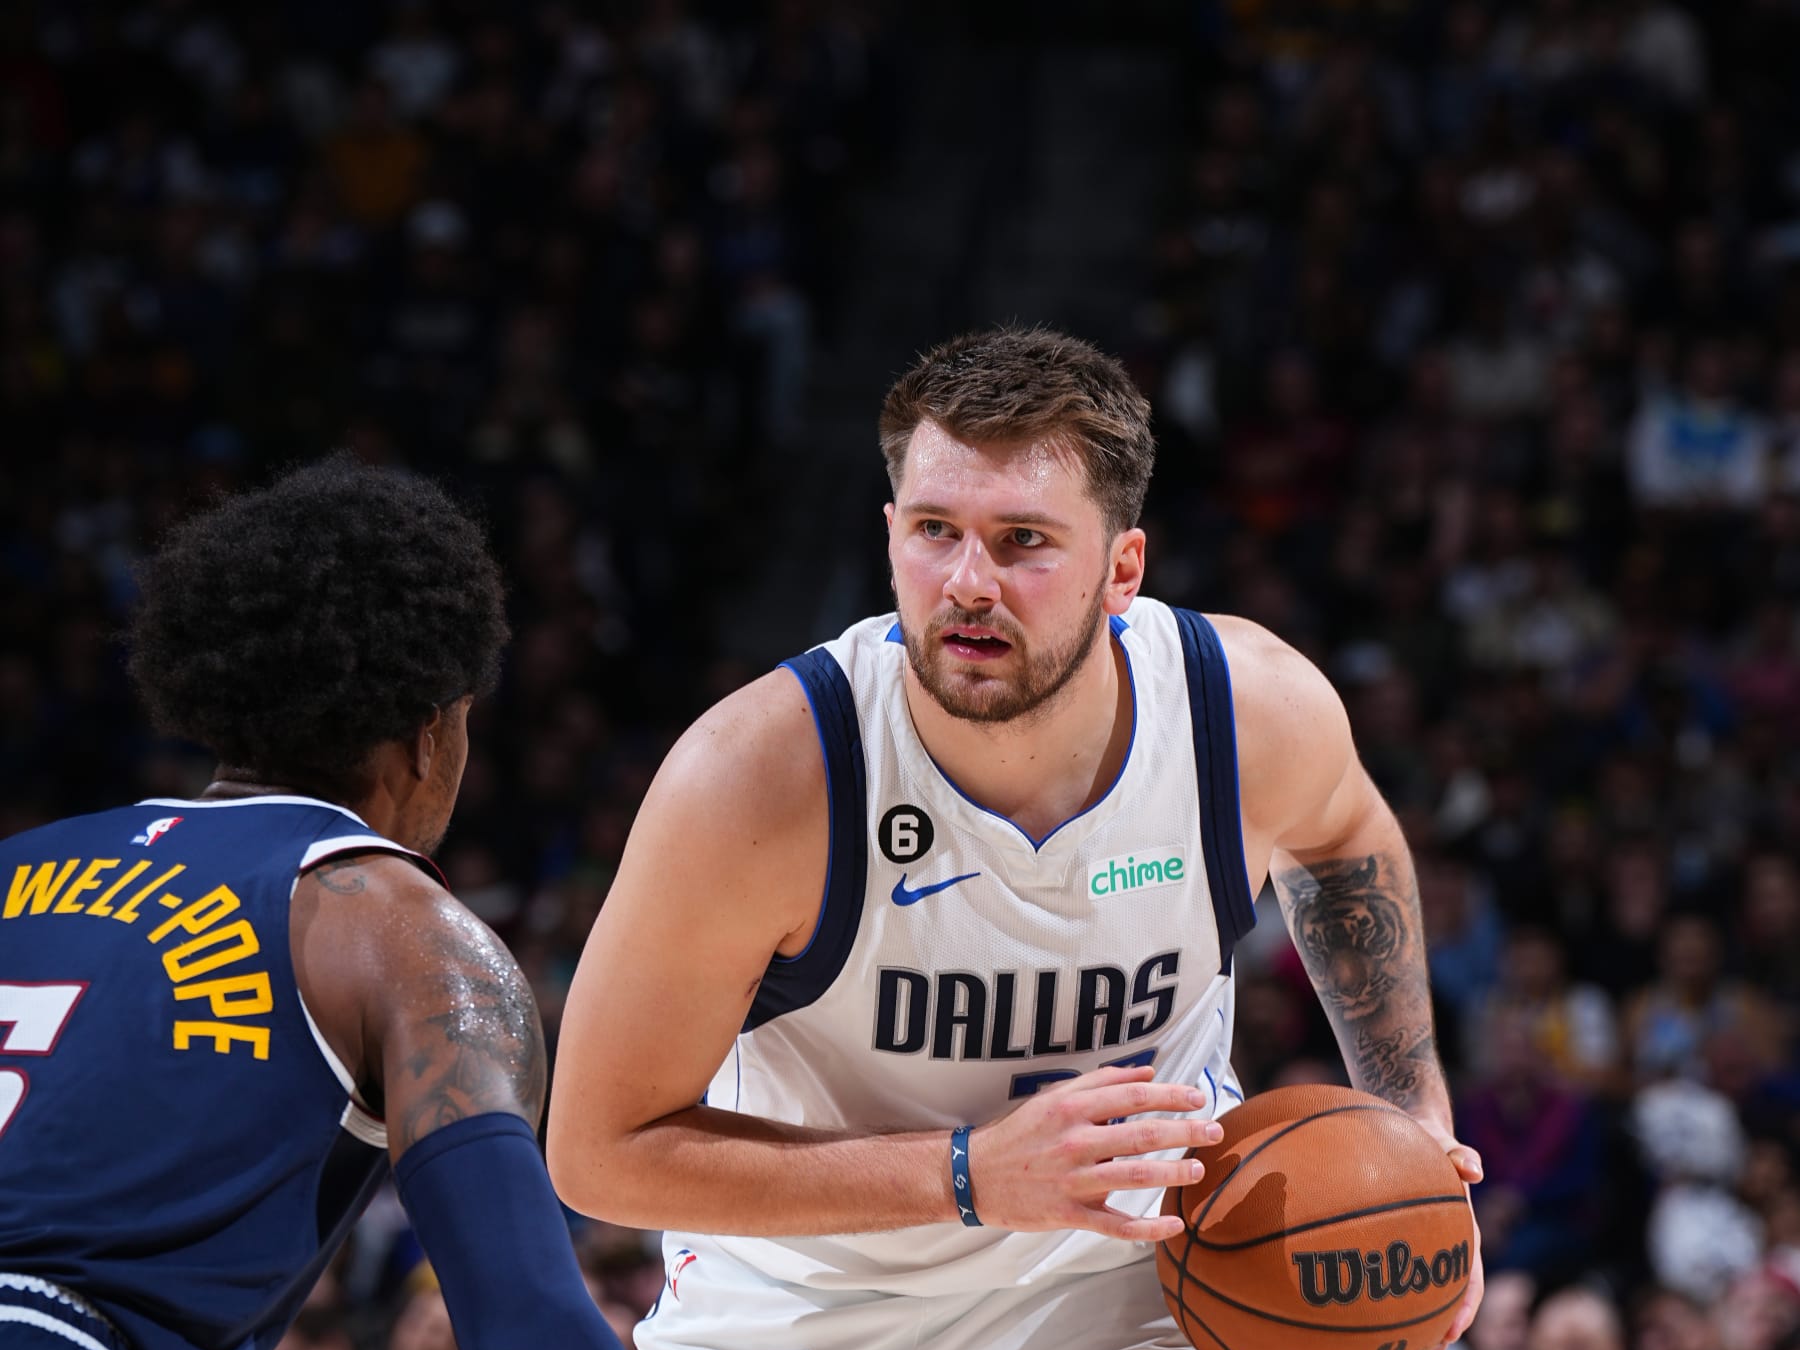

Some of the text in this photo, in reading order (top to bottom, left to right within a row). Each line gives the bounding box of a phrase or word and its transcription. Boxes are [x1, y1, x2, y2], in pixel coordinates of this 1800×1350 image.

[891, 813, 920, 857] 6
[1090, 856, 1185, 896] chime
[2, 857, 274, 1061] WELL-POPE
[871, 948, 1183, 1062] DALLAS
[1291, 1239, 1470, 1308] Wilson
